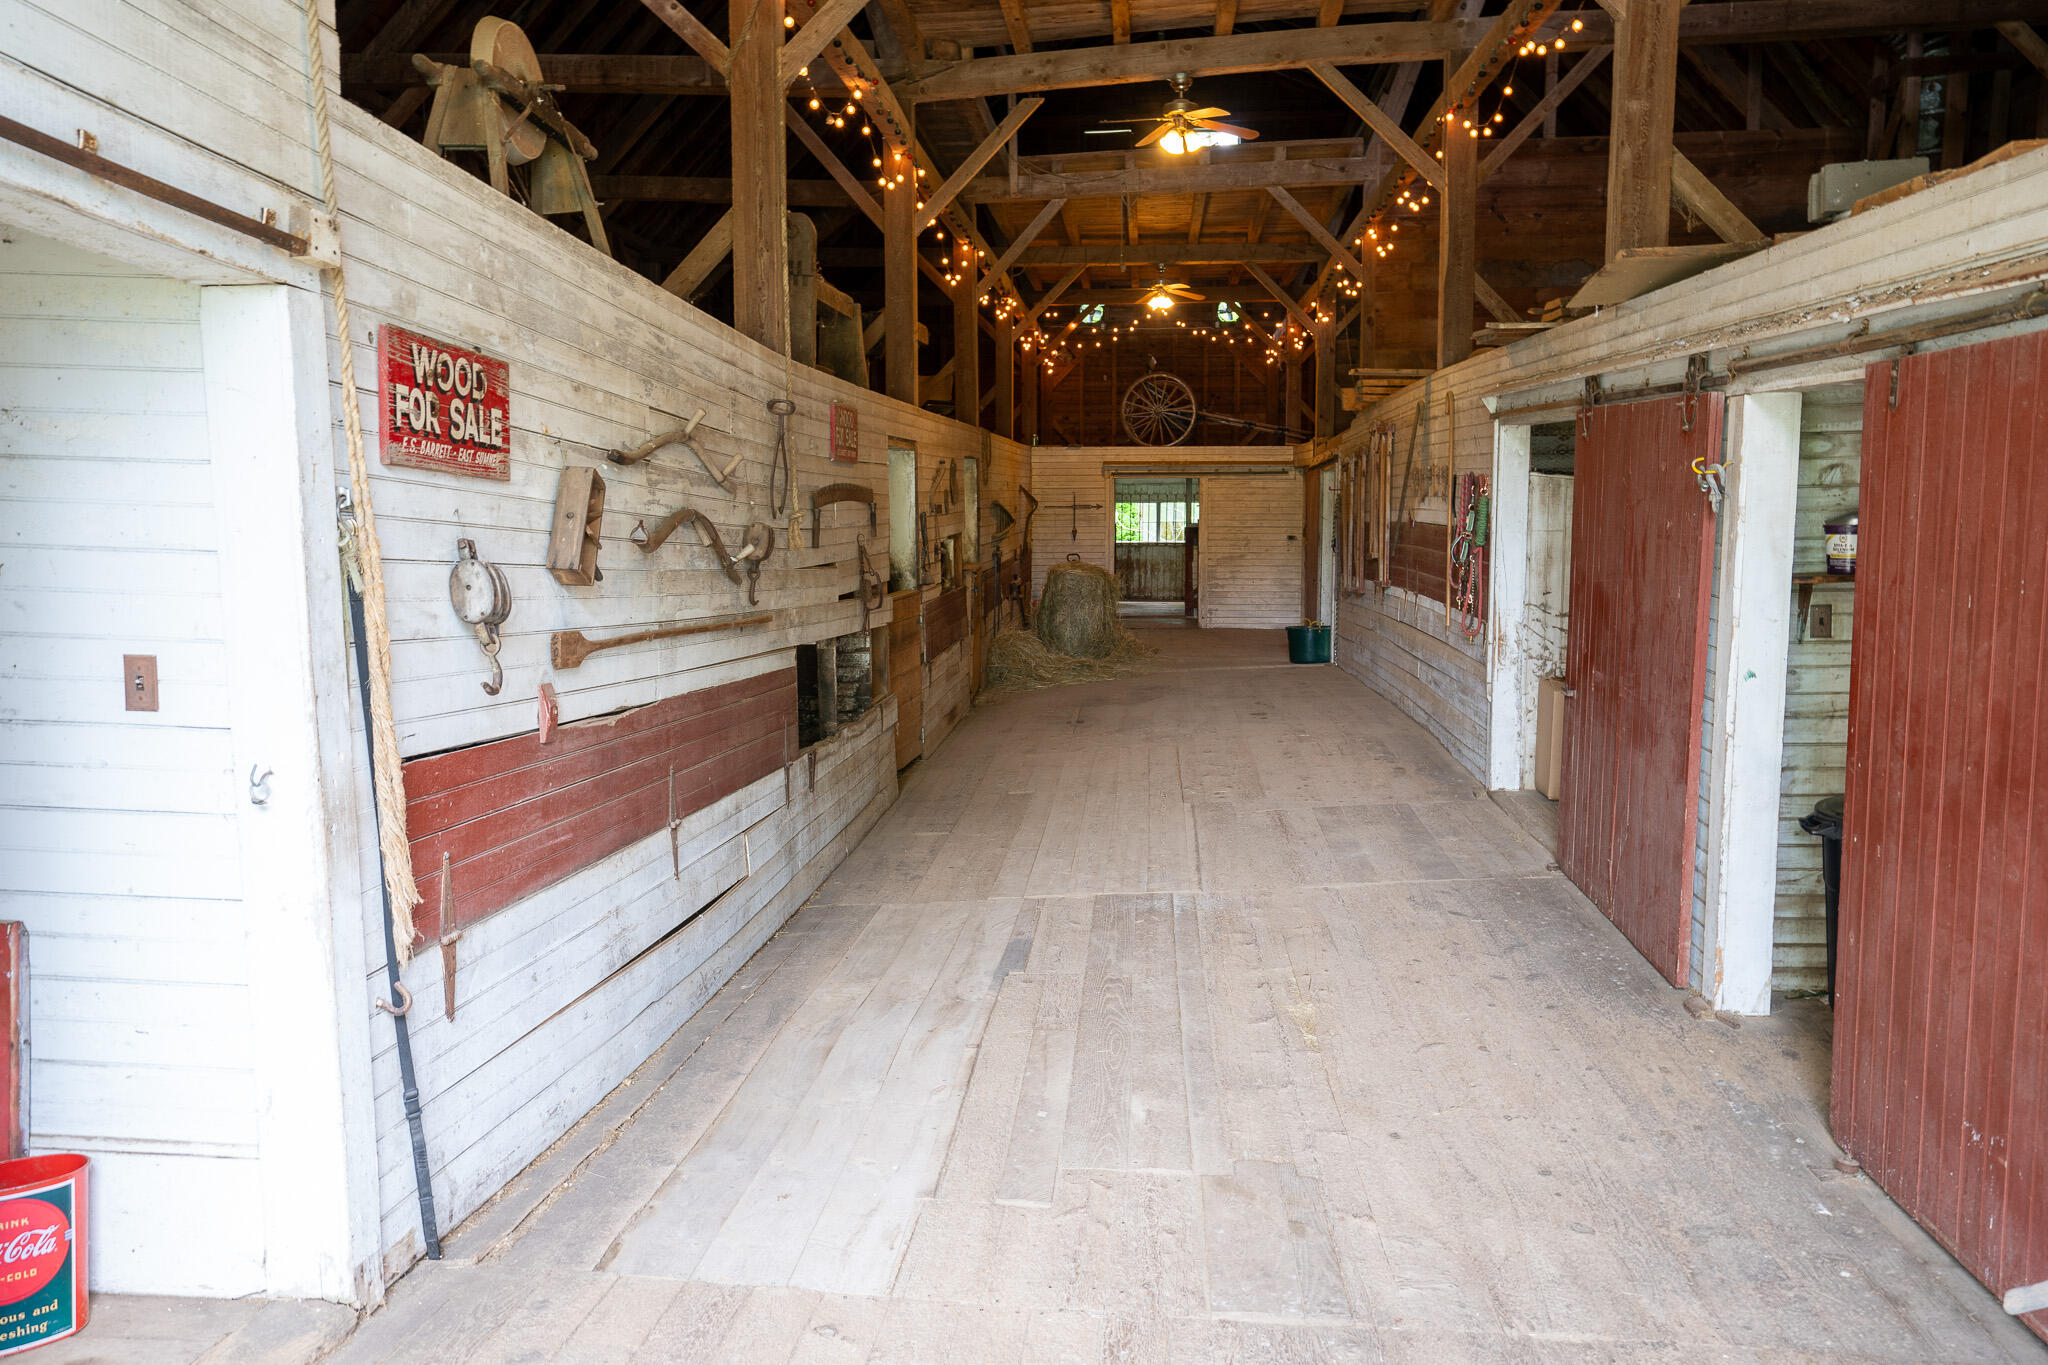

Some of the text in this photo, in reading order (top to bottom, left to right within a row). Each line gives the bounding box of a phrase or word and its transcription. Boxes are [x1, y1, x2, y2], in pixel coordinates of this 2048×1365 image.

[410, 342, 488, 402] WOOD
[394, 382, 503, 448] FOR SALE
[420, 439, 453, 459] BARRETT
[457, 447, 475, 464] EAST
[0, 1298, 59, 1325] ous and
[0, 1320, 49, 1341] eshing
